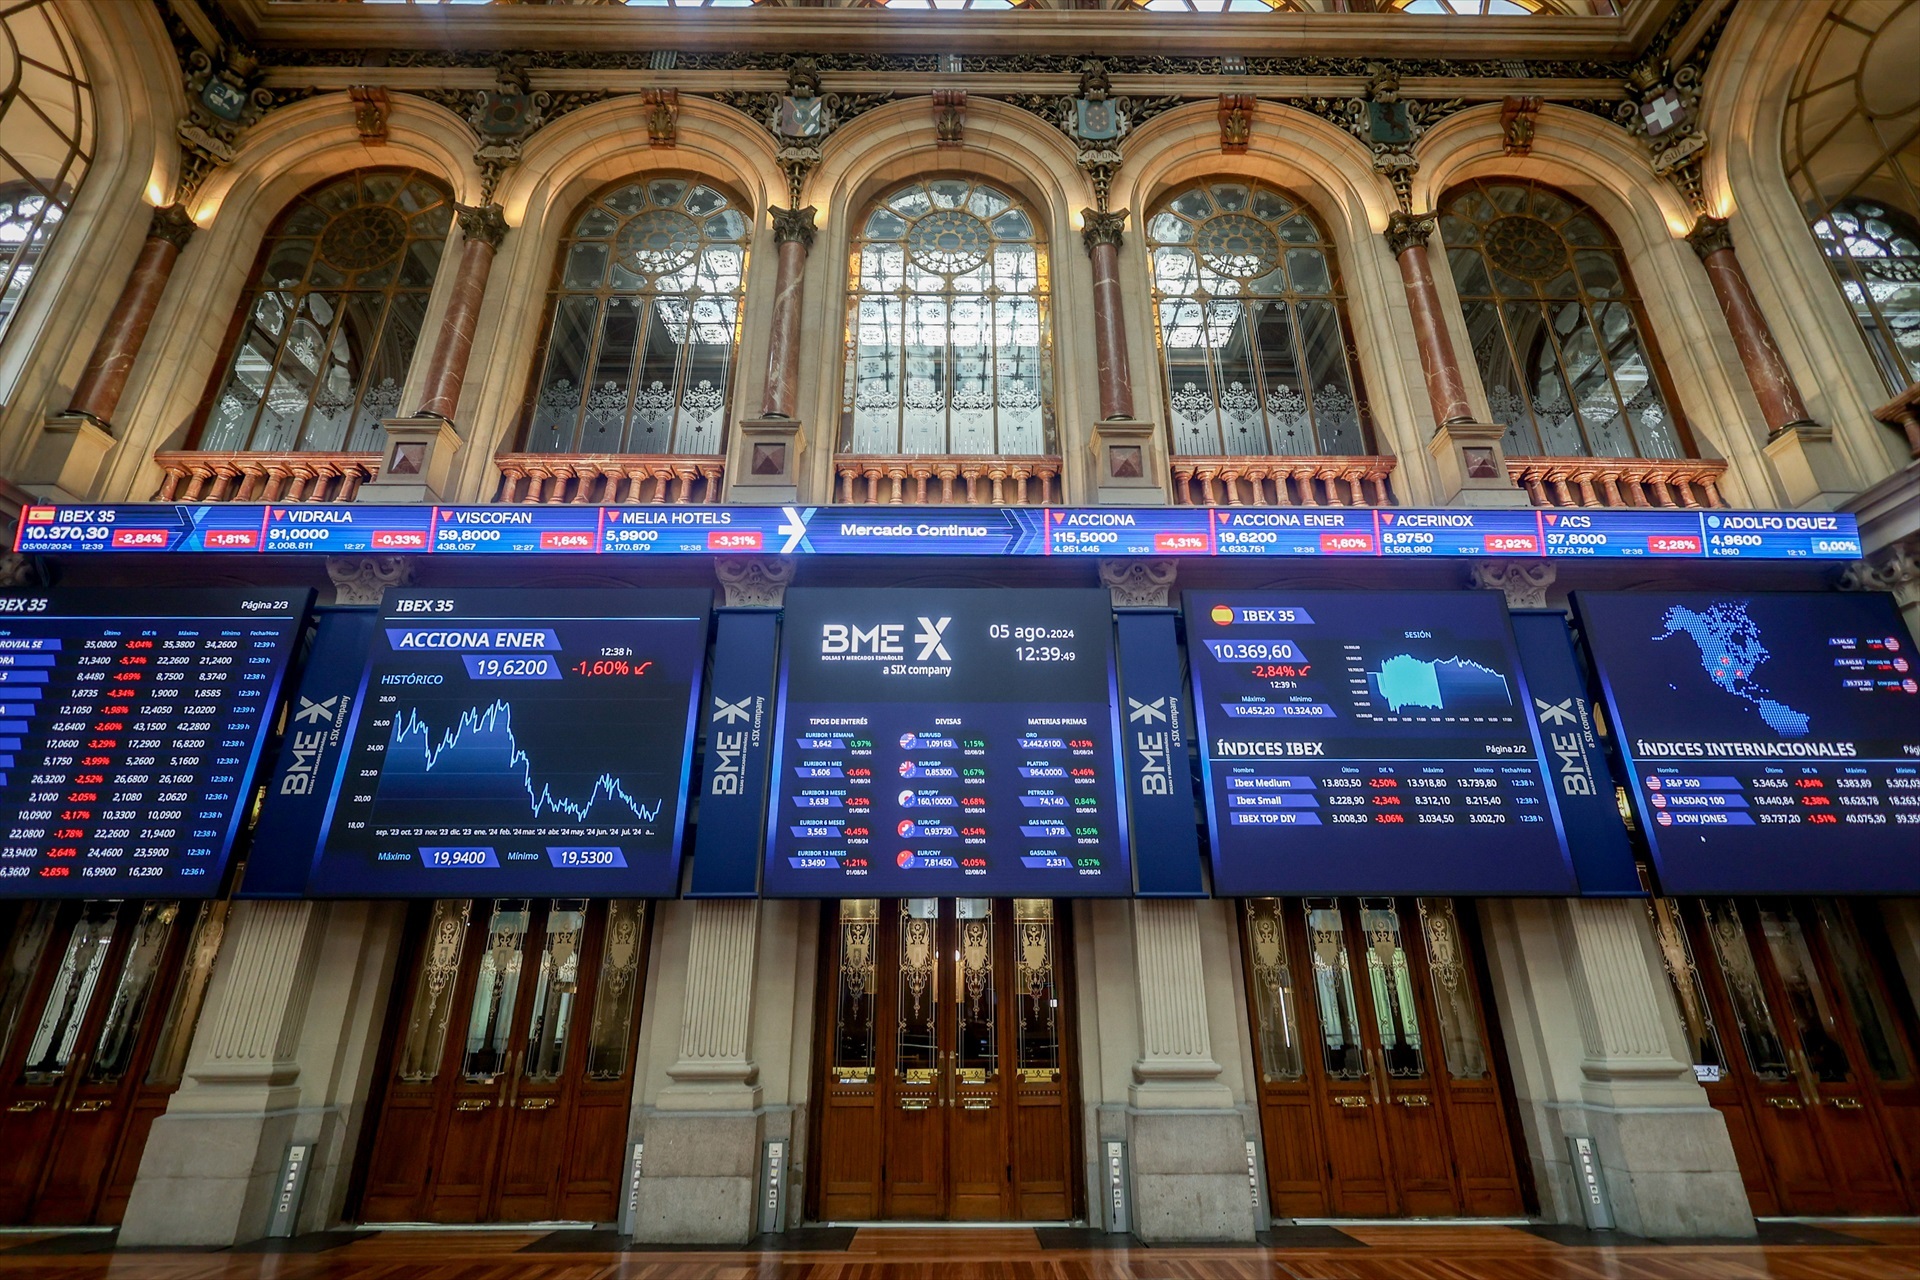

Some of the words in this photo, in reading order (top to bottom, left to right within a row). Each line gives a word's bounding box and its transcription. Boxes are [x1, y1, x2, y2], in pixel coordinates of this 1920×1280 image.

[1085, 151, 1114, 159] JAPON
[1664, 141, 1695, 162] SUIZA
[59, 510, 95, 522] IBEX
[97, 510, 116, 522] 35
[288, 510, 353, 523] VIDRALA
[456, 512, 533, 524] VISCOFAN
[622, 512, 668, 524] MELIA
[672, 512, 732, 524] HOTELS
[1068, 514, 1136, 526] ACCIONA
[1232, 514, 1300, 526] ACCIONA
[1304, 514, 1344, 526] ENER
[1396, 515, 1474, 527] ACERINOX
[1560, 516, 1591, 528] ACS
[1722, 517, 1784, 530] ADOLFO
[1786, 517, 1838, 530] DGUEZ
[26, 526, 109, 542] 10.370,30
[118, 534, 163, 546] -2,84%
[841, 524, 912, 536] Mercado
[916, 524, 987, 536] Continuo
[210, 534, 250, 545] -1,81%
[270, 529, 330, 542] 91,0000
[377, 535, 421, 546] -0,33%
[438, 530, 500, 542] 59,8000
[547, 536, 588, 547] -1,64%
[606, 530, 658, 542] 5,9900
[714, 536, 756, 547] -3,31%
[1053, 532, 1118, 544] 115,5000
[1160, 538, 1202, 549] -4,31%
[1218, 532, 1278, 544] 19,6200
[1326, 538, 1367, 550] -1,60%
[1382, 532, 1434, 545] 8,9750
[1489, 539, 1532, 550] -2,92%
[1548, 534, 1607, 546] 37,8000
[1652, 540, 1696, 551] -2,28%
[1710, 534, 1762, 548] 4,9600
[1818, 541, 1857, 552] 0,00%
[1548, 547, 1594, 555] 7.573.764
[1712, 548, 1740, 556] 4.860
[28, 599, 48, 611] 35
[241, 601, 271, 611] Página
[272, 601, 288, 610] 2/3
[396, 600, 434, 612] IBEX
[435, 600, 454, 612] 35
[1242, 610, 1276, 622] IBEX
[1278, 610, 1295, 622] 35
[822, 624, 904, 653] BME
[989, 624, 1010, 638] 05
[1014, 626, 1074, 642] ago.2024
[1404, 630, 1432, 638] SESIÓN
[84, 640, 116, 650] 35,0800
[162, 641, 195, 650] 35,3800
[204, 641, 238, 650] 34,2600
[399, 632, 490, 648] ACCIONA
[495, 632, 545, 648] ENER
[600, 648, 624, 656] 12:38
[1016, 647, 1076, 660] 12:39:49
[1214, 644, 1292, 661] 10.369,60
[477, 660, 548, 677] 19,6200
[572, 660, 629, 677] -1,60%
[883, 666, 890, 675] a
[890, 665, 906, 675] SIX
[908, 666, 952, 678] company
[1252, 666, 1295, 678] -2,84%
[381, 673, 444, 685] HISTÓRICO
[60, 706, 92, 716] 12,1050
[140, 706, 172, 716] 12,4050
[184, 706, 216, 716] 12,0200
[754, 696, 764, 729] company
[1170, 696, 1178, 729] company
[1235, 706, 1276, 716] 10.452,20
[1282, 706, 1322, 716] 10.324,00
[1576, 698, 1590, 730] company
[330, 728, 340, 741] SIX
[335, 696, 350, 728] company
[840, 716, 868, 726] INTERÉS
[752, 729, 760, 742] SIX
[1171, 730, 1180, 742] SIX
[1584, 730, 1594, 742] SIX
[850, 740, 872, 748] 0,97%
[926, 740, 952, 749] 1,09163
[964, 740, 984, 748] 1,15%
[1216, 739, 1283, 756] ÍNDICES
[1286, 742, 1324, 756] IBEX
[1485, 745, 1512, 754] Página
[1513, 745, 1526, 754] 2/2
[1636, 738, 1704, 756] ÍNDICES
[1704, 742, 1857, 757] INTERNACIONALES
[280, 731, 322, 795] BME
[712, 732, 742, 795] BME
[1136, 732, 1166, 795] BME
[1550, 733, 1590, 796] BME
[1234, 779, 1254, 788] Ibex
[1255, 779, 1291, 788] Medium
[1322, 780, 1362, 788] 13.803,50
[1407, 779, 1447, 788] 13.918,80
[1457, 779, 1497, 788] 13.739,80
[1665, 780, 1683, 788] S&P
[1684, 780, 1700, 788] 500
[1752, 780, 1788, 788] 5.346,56
[1040, 798, 1064, 806] 74,140
[1236, 796, 1256, 805] Ibex
[1258, 796, 1282, 805] Small
[1330, 796, 1365, 806] 8.228,90
[1415, 796, 1450, 806] 8.312,10
[1466, 796, 1501, 806] 8.215,40
[1670, 796, 1708, 807] NASDAQ
[1708, 796, 1725, 806] 100
[1754, 796, 1795, 806] 18.440,84
[18, 810, 52, 820] 10,0900
[102, 810, 136, 820] 10,3300
[147, 810, 182, 820] 10,0900
[1239, 814, 1260, 823] IBEX
[1260, 814, 1280, 823] TOP
[1280, 814, 1296, 823] DIV
[1332, 814, 1368, 824] 3.008,30
[1418, 814, 1454, 824] 3.034,50
[1469, 814, 1505, 824] 3.002,70
[1676, 814, 1699, 823] DOW
[1700, 814, 1728, 824] JONES
[1760, 814, 1801, 824] 39.737,20
[1846, 814, 1886, 824] 40.075,30
[1046, 828, 1065, 836] 1,978
[1076, 828, 1098, 836] 0,56%
[378, 852, 411, 861] Máximo
[433, 851, 486, 867] 19,9400
[507, 852, 539, 861] Mínimo
[560, 851, 613, 867] 19,5300
